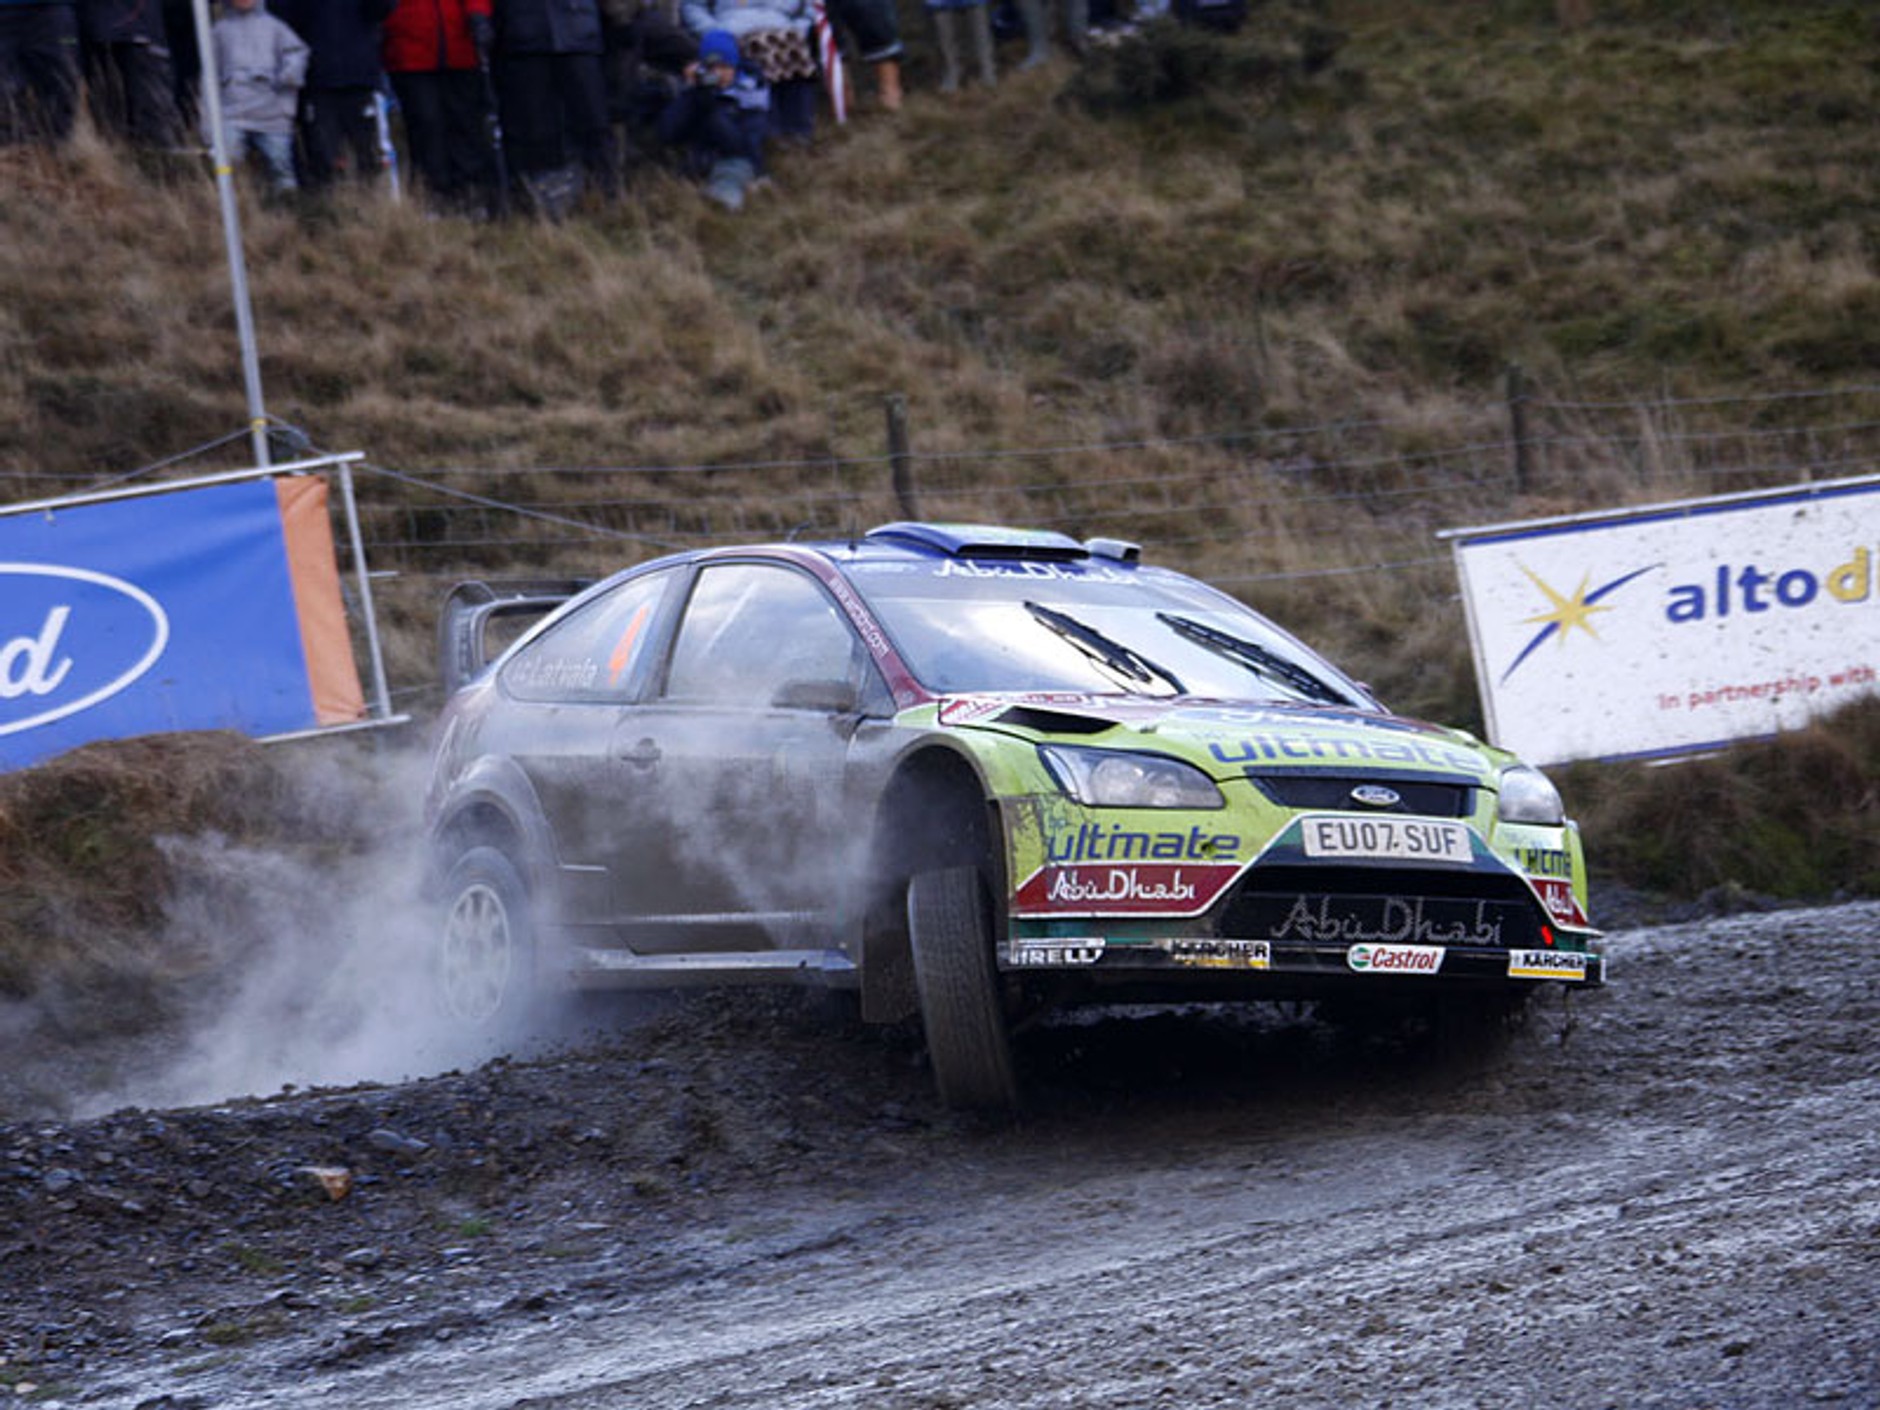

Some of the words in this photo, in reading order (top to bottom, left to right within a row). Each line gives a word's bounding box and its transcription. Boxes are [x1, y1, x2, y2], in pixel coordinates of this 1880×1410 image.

[1666, 545, 1880, 623] altod
[1689, 673, 1821, 712] partnership
[1209, 734, 1485, 776] ultimate
[1049, 823, 1240, 861] ultimate
[1318, 822, 1394, 851] EU07
[1405, 824, 1457, 854] SUF
[1372, 947, 1438, 970] Castrol
